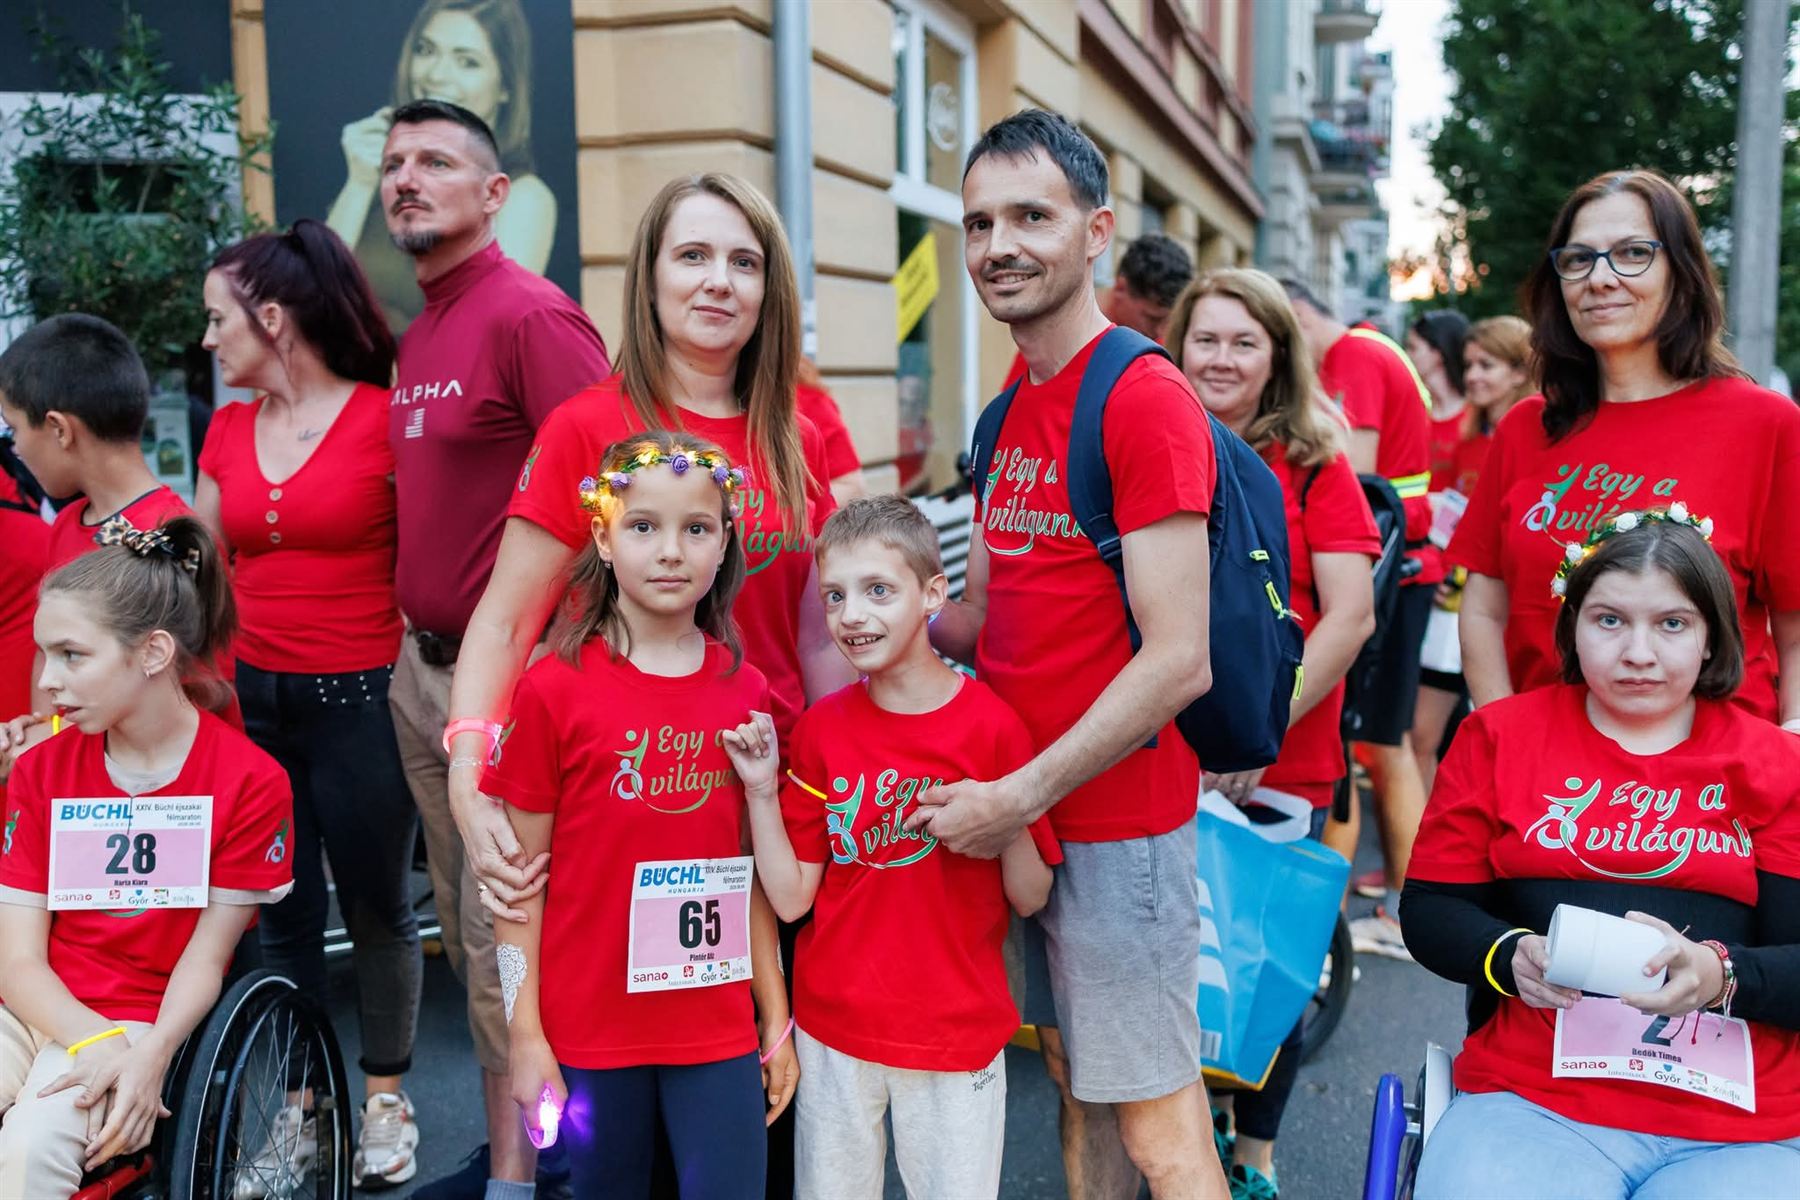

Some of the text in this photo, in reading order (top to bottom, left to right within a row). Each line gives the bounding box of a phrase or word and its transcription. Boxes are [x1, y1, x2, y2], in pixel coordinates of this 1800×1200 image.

[1006, 447, 1058, 493] Egy a
[1582, 463, 1678, 501] Egy a
[657, 725, 704, 761] Egy
[60, 803, 134, 821] BÜCHL
[1609, 780, 1726, 821] Egy a
[105, 833, 156, 875] 28
[640, 865, 705, 887] BÜCHL
[679, 899, 721, 949] 65
